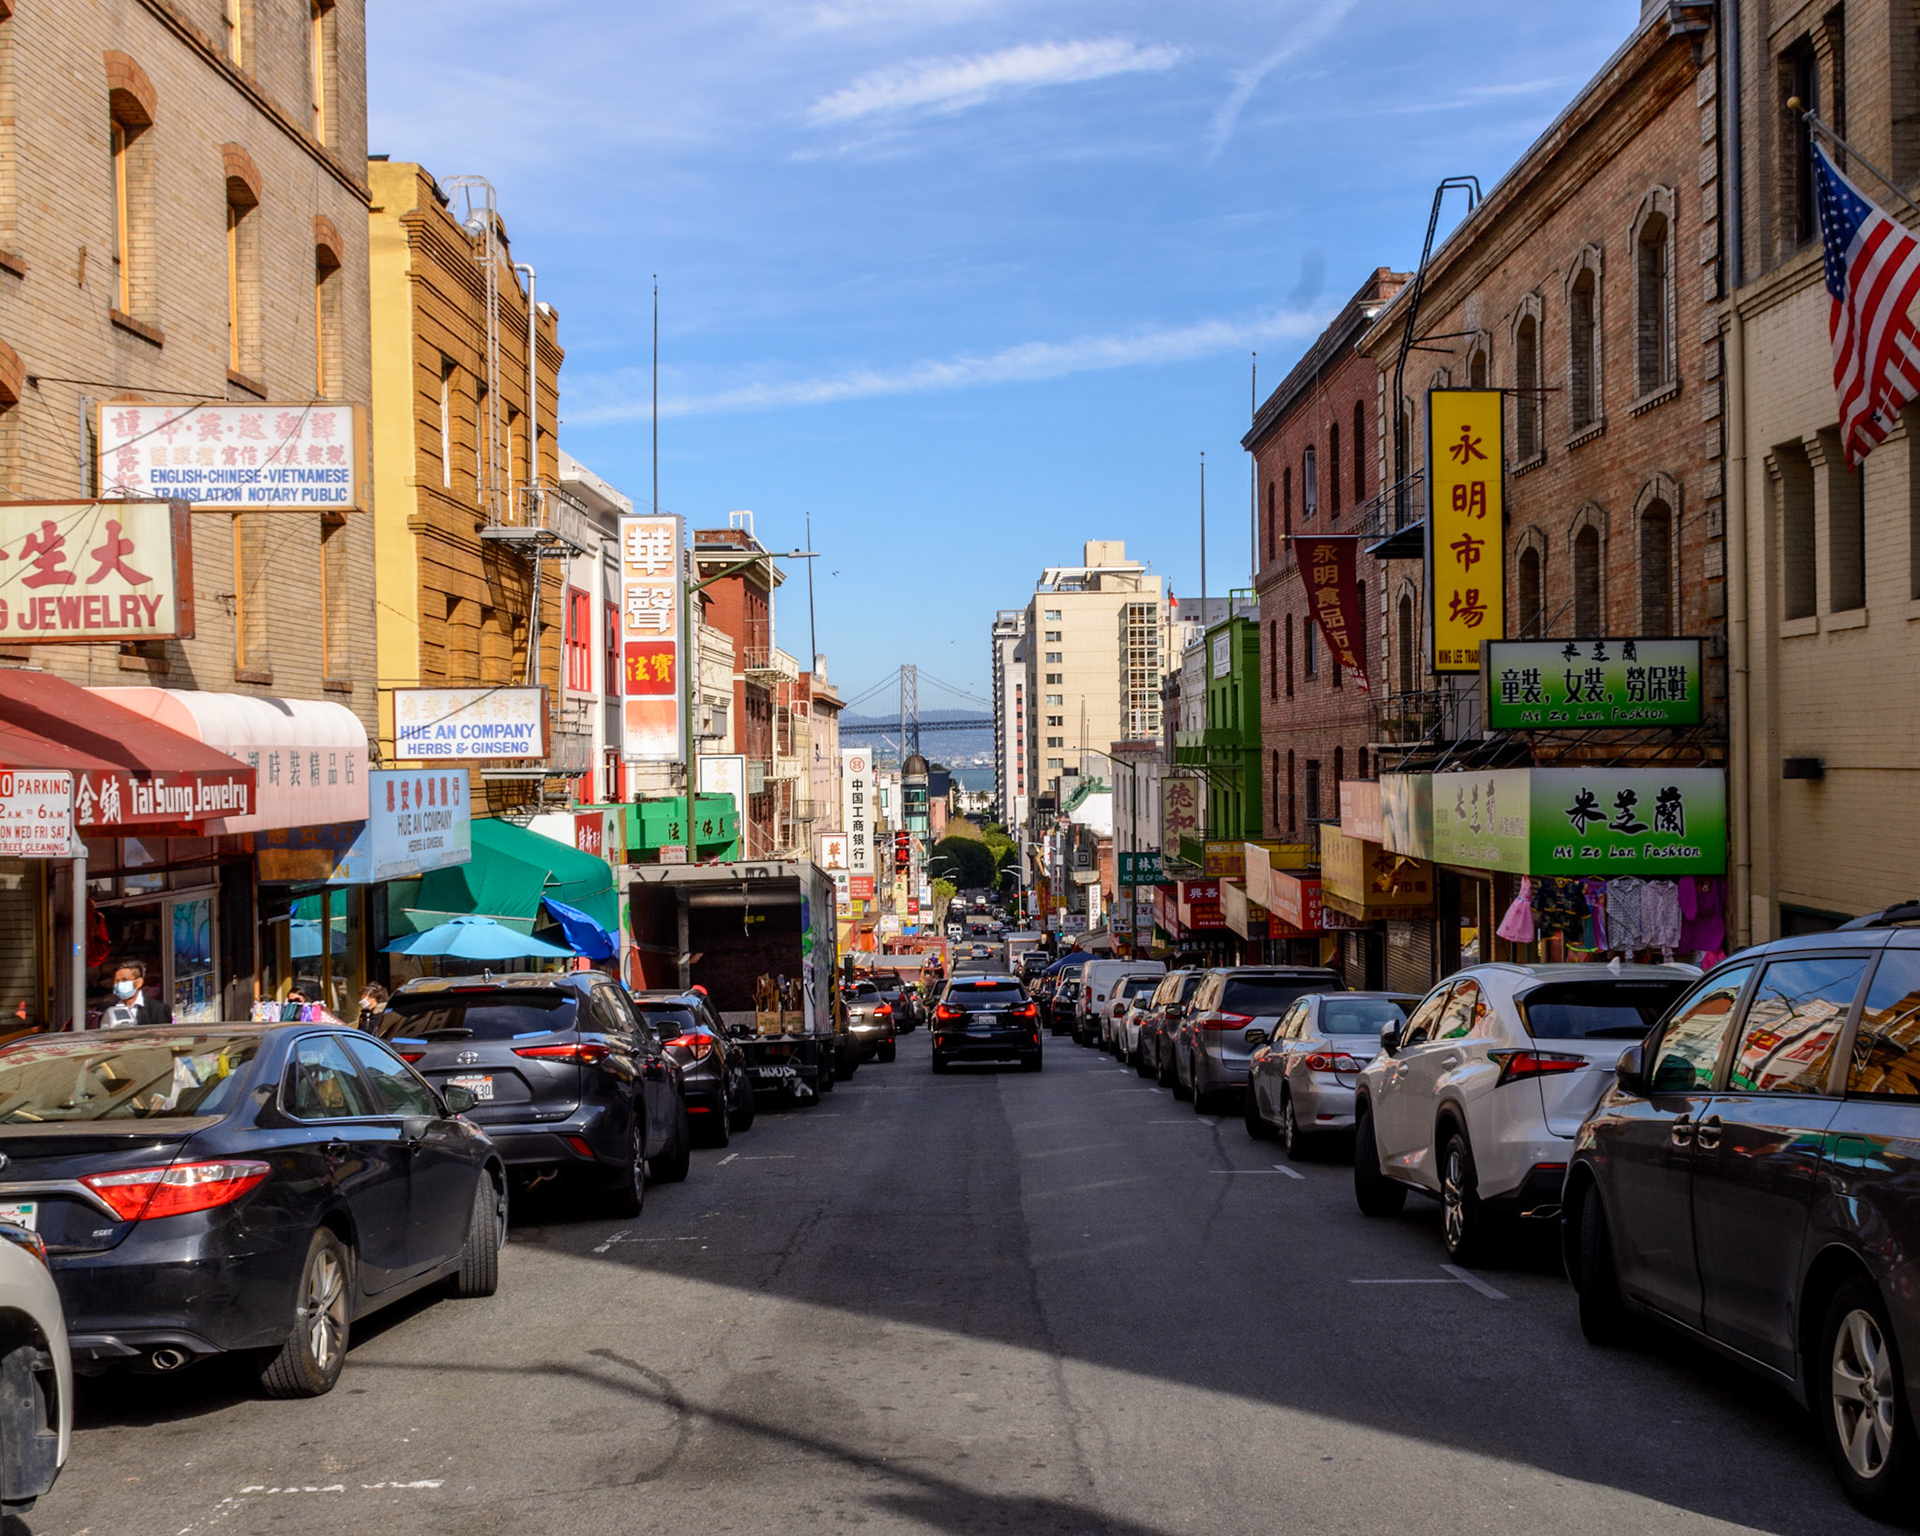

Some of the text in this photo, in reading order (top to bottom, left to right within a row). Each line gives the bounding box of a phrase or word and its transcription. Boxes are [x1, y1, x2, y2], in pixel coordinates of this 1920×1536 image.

[153, 487, 347, 502] TRANSLATION NOTARY PUBLIC
[1449, 425, 1488, 628] 永明市場
[17, 594, 164, 631] JEWELRY
[1561, 641, 1637, 662] 米芝蘭
[1521, 706, 1669, 721] Mi Ze Lan Fashion
[400, 723, 535, 740] HUE AN COMPANY
[407, 741, 529, 755] HERBS & GINSENG
[1, 773, 69, 797] O PARKING
[195, 776, 248, 816] Jewelry
[38, 804, 47, 819] 6
[852, 778, 865, 861] 中国工商银行
[1565, 785, 1686, 839] 米芝蘭
[0, 825, 65, 839] ON WED FRI SAT
[397, 810, 453, 836] HUE AN COMPANY
[668, 817, 725, 841] 法佛具
[0, 843, 64, 852] REET CLEANING
[1206, 844, 1231, 854] CHINESE
[1553, 844, 1701, 859] Mi Ze Lan Fashion
